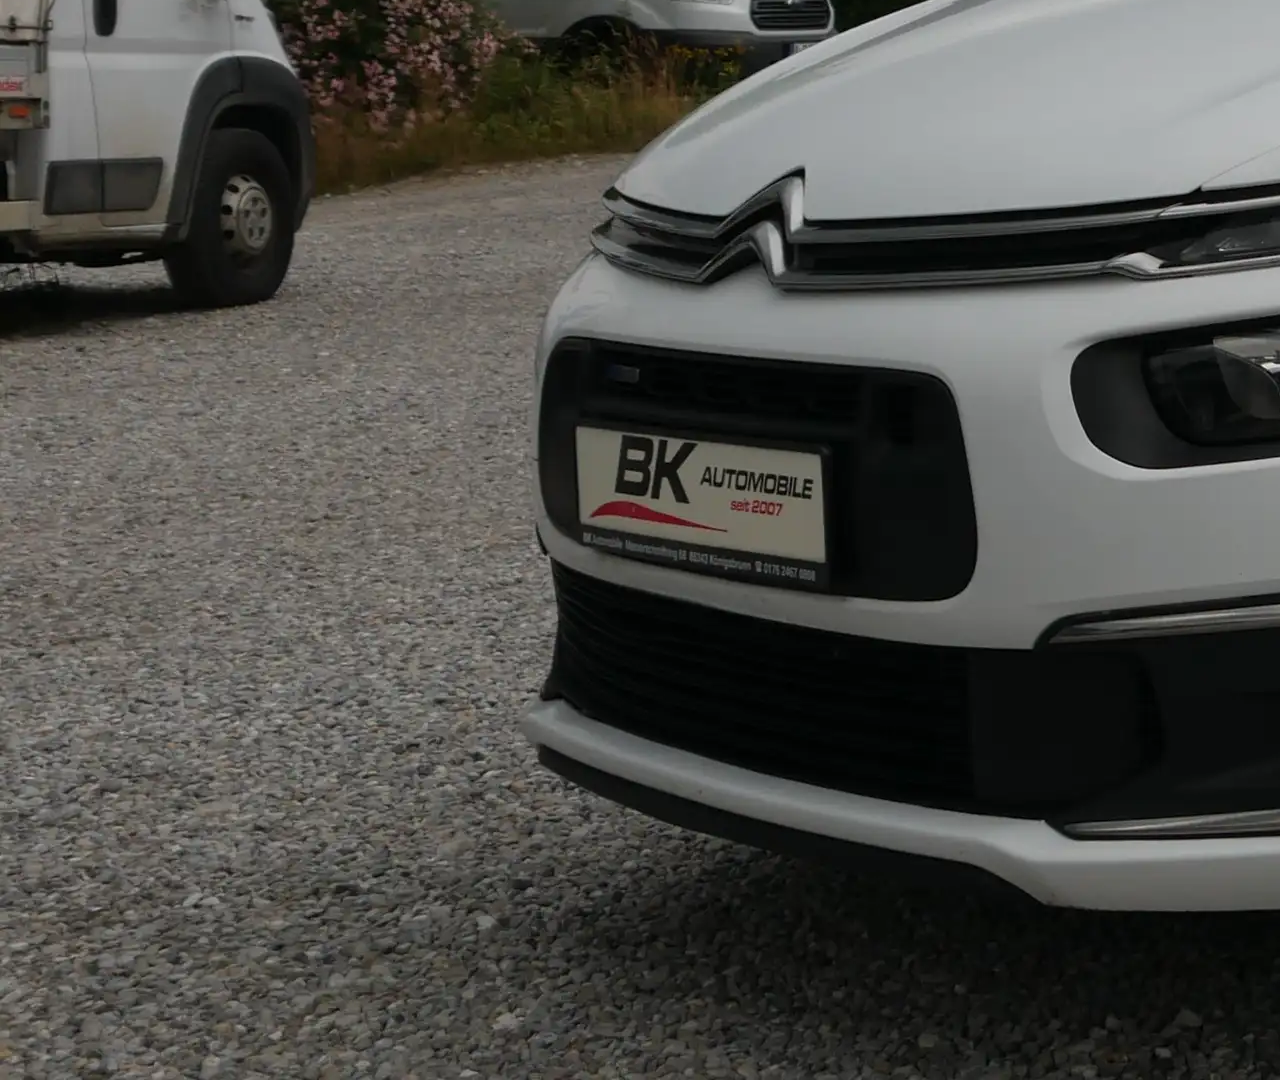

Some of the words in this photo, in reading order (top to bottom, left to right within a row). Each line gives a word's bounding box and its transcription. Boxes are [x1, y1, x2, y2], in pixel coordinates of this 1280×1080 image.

[614, 434, 698, 504] BK
[700, 466, 814, 500] AUTOMOBILE
[730, 498, 750, 513] seit
[751, 499, 783, 517] 2007
